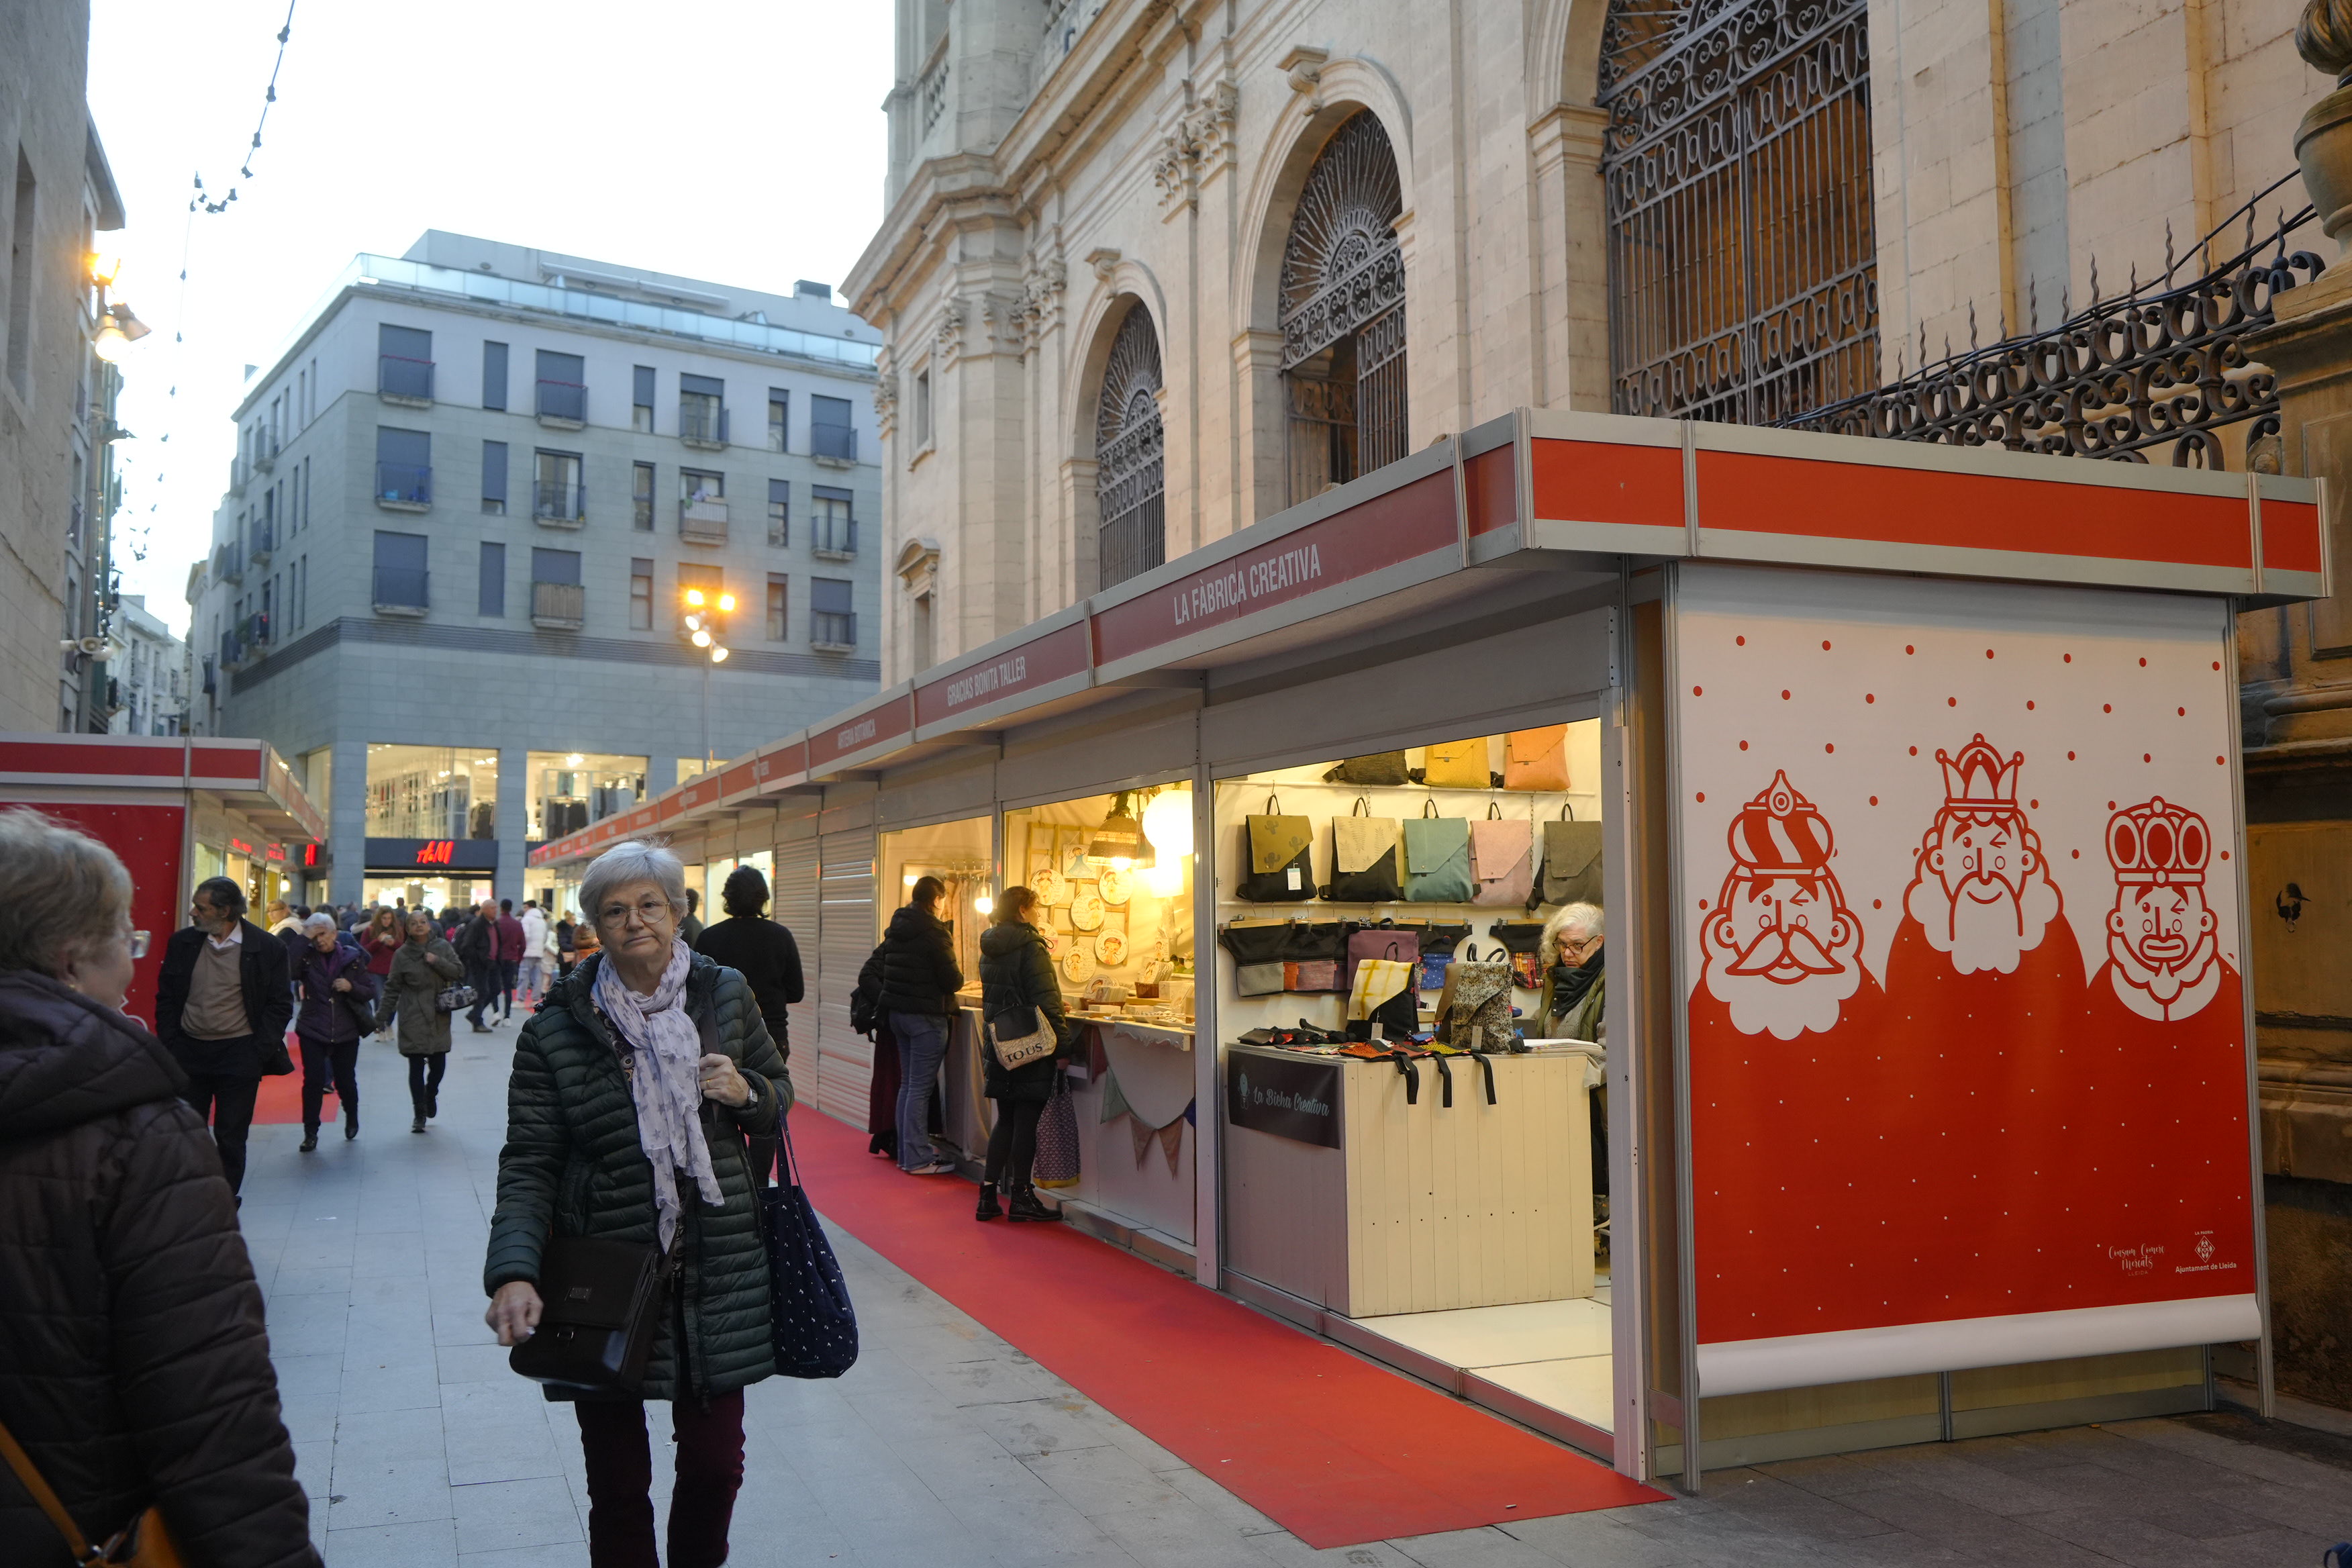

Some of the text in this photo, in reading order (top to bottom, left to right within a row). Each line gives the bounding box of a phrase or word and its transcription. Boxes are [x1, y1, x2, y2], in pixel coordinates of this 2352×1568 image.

[1174, 544, 1321, 625] LA FÀBRICA CREATIVA
[947, 656, 1026, 706] GRACIAS BONITA TALLER
[417, 840, 454, 865] H&M
[1005, 1043, 1042, 1063] TOUS
[1253, 1086, 1329, 1116] La Bicha Creativa
[2122, 1255, 2153, 1271] Mercats
[2175, 1265, 2210, 1273] Ajuntament
